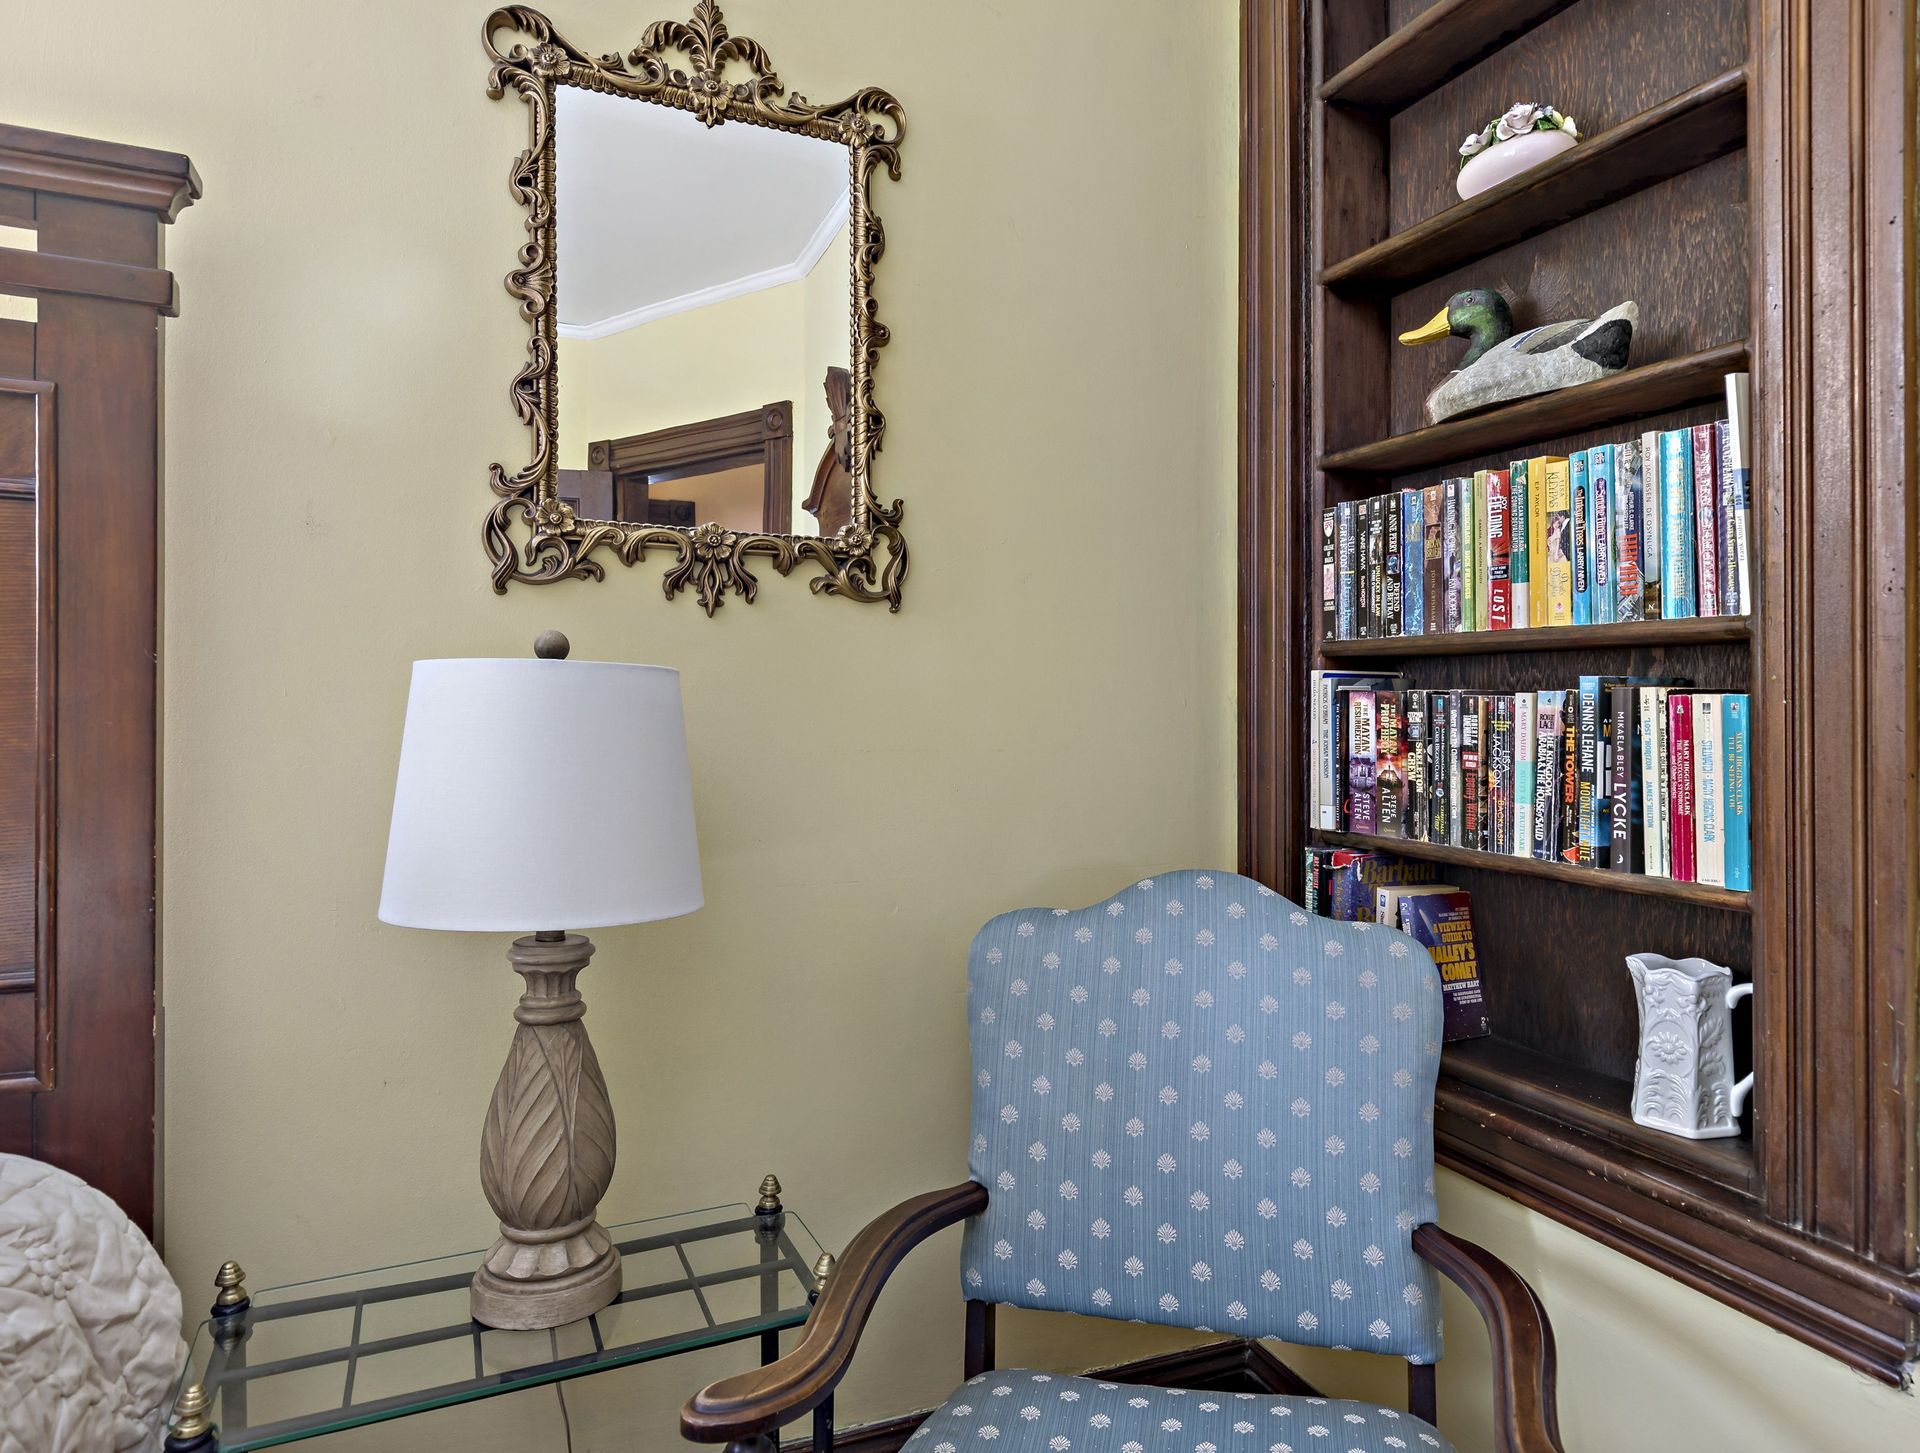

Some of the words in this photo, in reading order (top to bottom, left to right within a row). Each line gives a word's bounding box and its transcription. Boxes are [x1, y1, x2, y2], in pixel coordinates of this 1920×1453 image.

[1575, 496, 1585, 524] Integral
[1596, 490, 1606, 517] Smoke
[1647, 507, 1653, 518] DE
[1389, 514, 1397, 533] ANNE
[1490, 496, 1502, 538] FIELDING
[1596, 517, 1606, 537] Ring
[1340, 523, 1348, 569] GRAFTON
[1389, 533, 1397, 553] PERRY
[1575, 524, 1585, 546] Trees
[1575, 547, 1585, 570] LARRY
[1596, 537, 1606, 562] LARRY
[1575, 570, 1585, 591] NIVEN
[1596, 562, 1606, 584] NIVEN
[1375, 594, 1381, 602] IN
[1449, 588, 1457, 617] HOOPER
[1491, 588, 1506, 623] LOST
[1450, 709, 1458, 727] Where
[1520, 711, 1528, 731] MARY
[1581, 692, 1595, 732] DENNIS
[1354, 701, 1362, 755] RESURRECTION
[1362, 717, 1371, 752] MAYAN
[1381, 703, 1390, 754] PROPHECY
[1389, 718, 1397, 754] MAYAN
[1450, 727, 1458, 739] Are
[1462, 715, 1472, 746] TANENBAUM
[1546, 732, 1555, 749] THE
[1565, 726, 1576, 752] THE
[1616, 711, 1625, 752] MIKAELA
[1450, 739, 1458, 749] The
[1520, 732, 1528, 761] DAHEIM
[1537, 731, 1547, 762] ARABIA
[1581, 735, 1595, 773] LEHANE
[1702, 739, 1714, 774] STILLWATCH
[1728, 752, 1735, 761] BE
[1407, 752, 1416, 781] CREW
[1415, 742, 1424, 794] SKELETON
[1450, 749, 1458, 774] Children?
[1492, 733, 1502, 789] JACKSON
[1503, 750, 1511, 773] LISA
[1546, 750, 1555, 796] KINGDOM
[1616, 755, 1625, 778] BLEY
[1465, 773, 1477, 800] Enemy
[1537, 770, 1547, 786] THE
[1565, 753, 1576, 803] TOWER
[1702, 779, 1714, 797] MARY
[1537, 786, 1547, 812] HOUSE
[1646, 781, 1654, 802] JAMES
[1363, 793, 1371, 820] STEVE
[1381, 787, 1391, 823] ALTEN
[1450, 806, 1458, 819] Clark
[1465, 803, 1477, 831] Within
[1579, 781, 1591, 838] MOONLIGHT
[1613, 782, 1627, 840] LYCKE
[1702, 797, 1714, 823] HIGGINS
[1537, 817, 1547, 841] SAUD
[1702, 823, 1714, 843] CLARK
[1579, 839, 1591, 862] MILE
[1362, 856, 1437, 885] Barbara
[1433, 924, 1439, 933] A
[1440, 920, 1472, 934] VIEWER'S
[1441, 931, 1463, 943] GUIDE
[1462, 930, 1473, 941] TO
[1429, 941, 1476, 964] HALLEY'S
[1440, 960, 1478, 983] COMET
[1443, 981, 1466, 992] MATTHEW
[1466, 979, 1480, 989] HART
